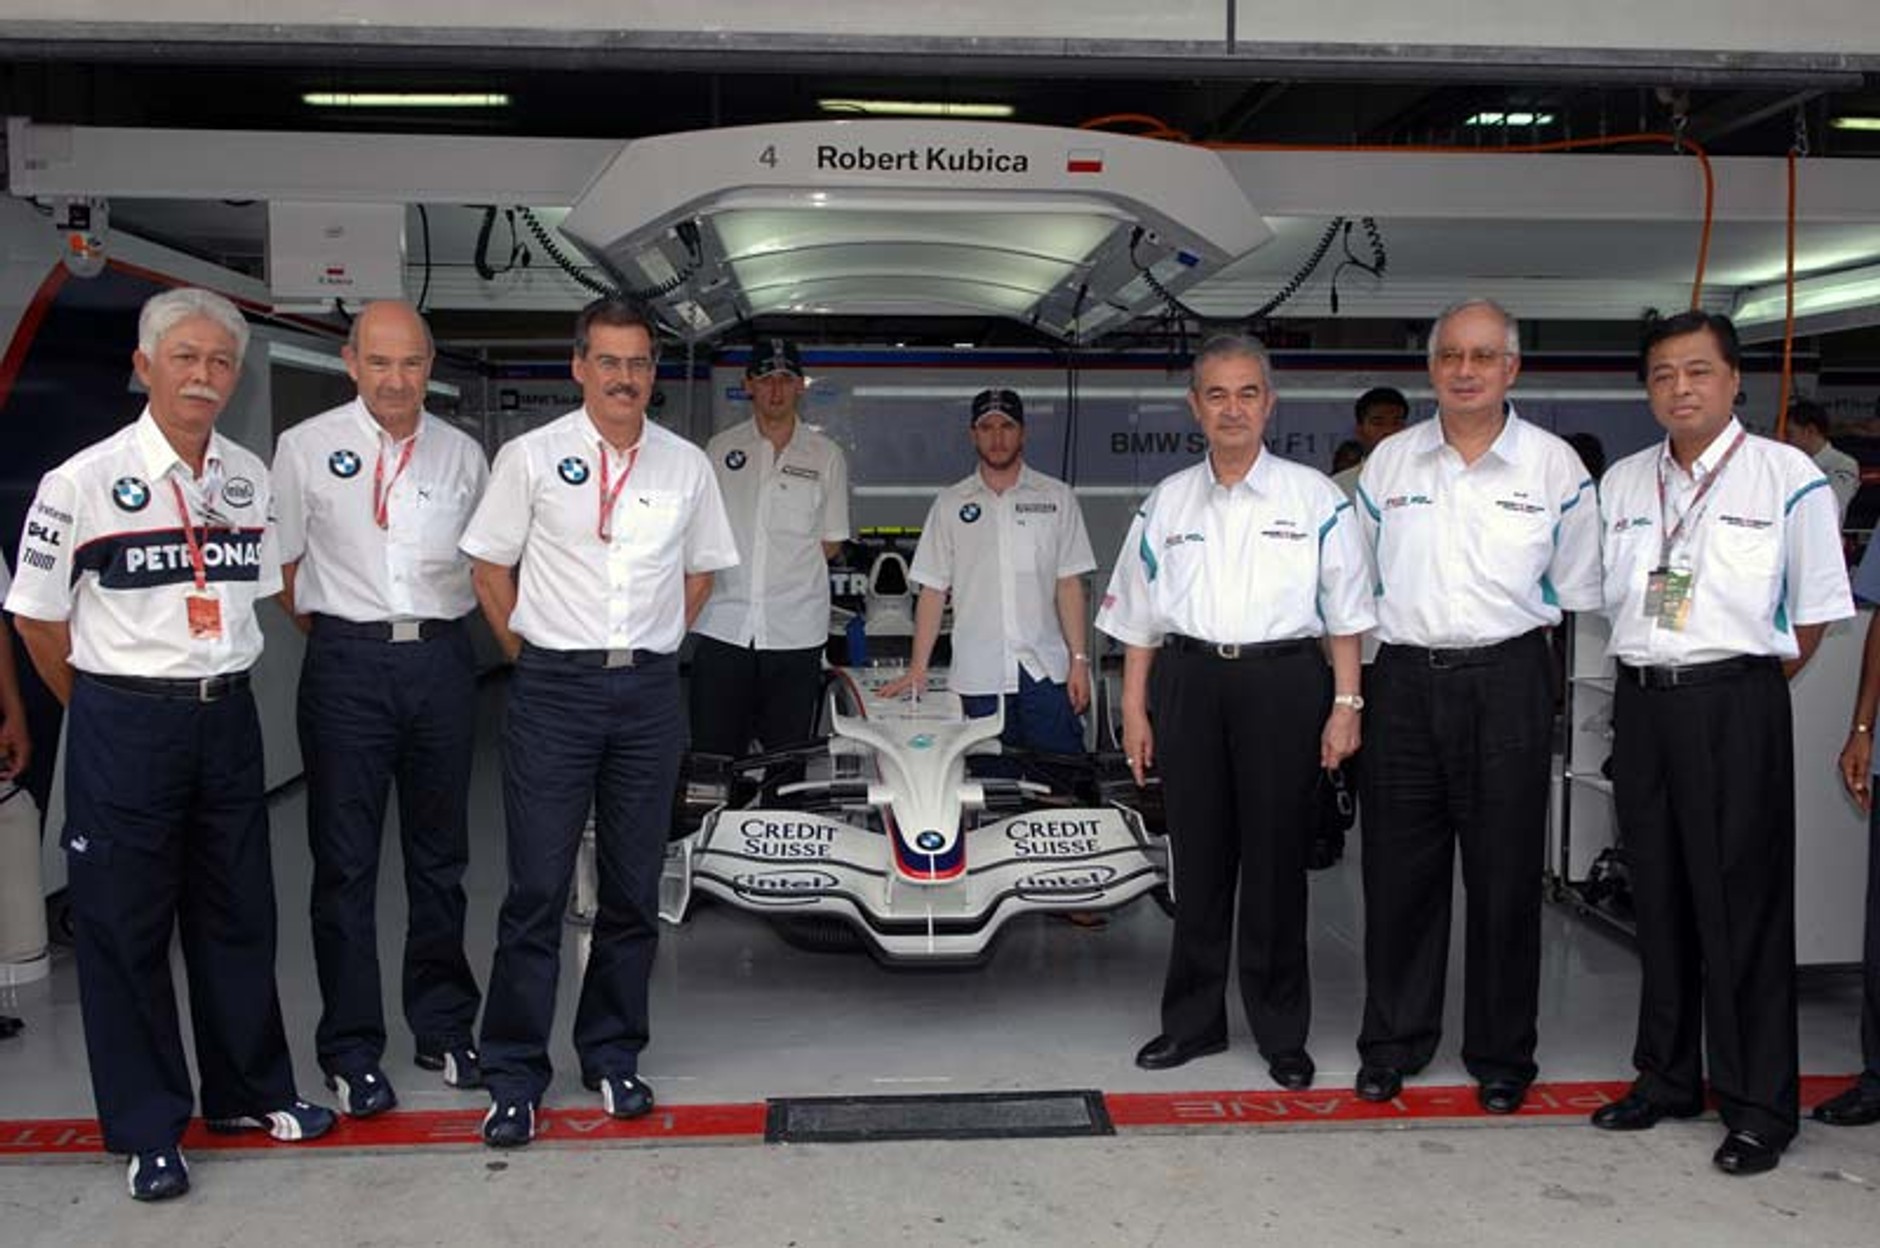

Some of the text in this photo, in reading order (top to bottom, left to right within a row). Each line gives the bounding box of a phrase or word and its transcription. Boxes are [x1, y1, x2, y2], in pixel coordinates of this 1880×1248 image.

[759, 145, 1030, 173] 4 Robert Kubica
[1111, 431, 1181, 454] BMW
[1285, 432, 1316, 454] F1
[741, 819, 838, 842] CREDIT
[1006, 820, 1102, 841] CREDIT
[744, 839, 832, 858] SUISSE
[1014, 838, 1101, 857] SUISSE
[746, 873, 822, 889] intel
[1026, 870, 1100, 887] intel
